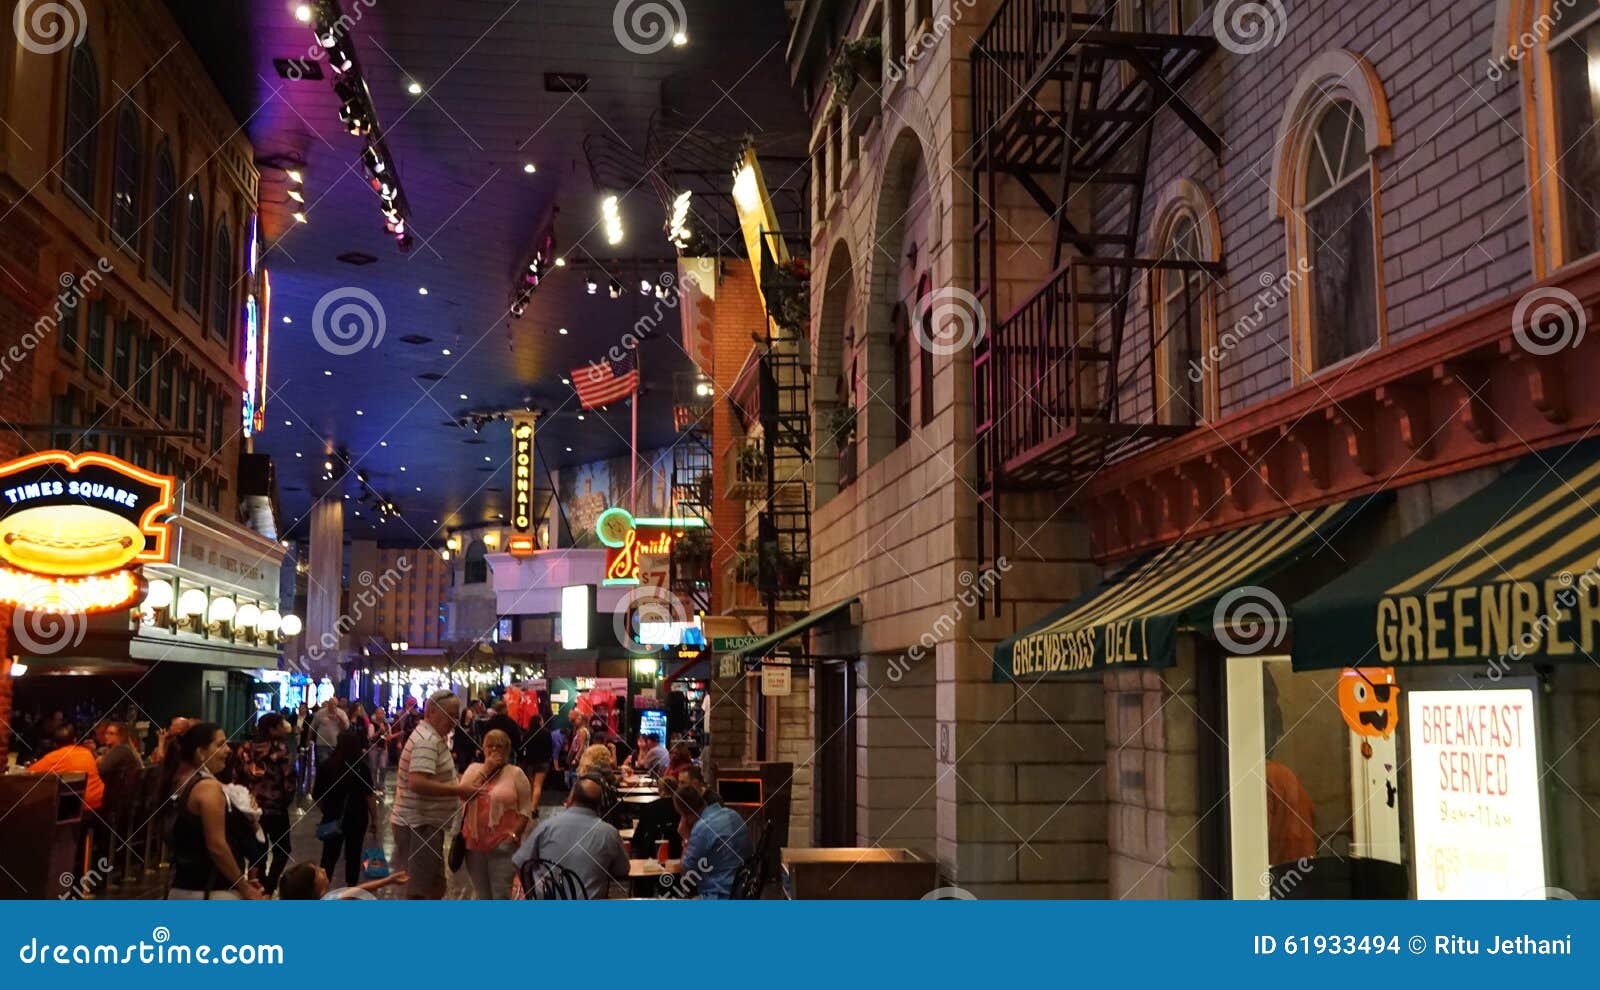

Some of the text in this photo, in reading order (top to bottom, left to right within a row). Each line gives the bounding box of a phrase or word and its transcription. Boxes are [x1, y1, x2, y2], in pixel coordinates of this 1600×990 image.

[5, 481, 138, 507] TIMES SQUARE
[517, 441, 529, 528] FORNAIO
[1013, 624, 1096, 676] GREENBERGS
[1422, 704, 1522, 748] BREAKFAST
[1440, 751, 1508, 796] SERVED
